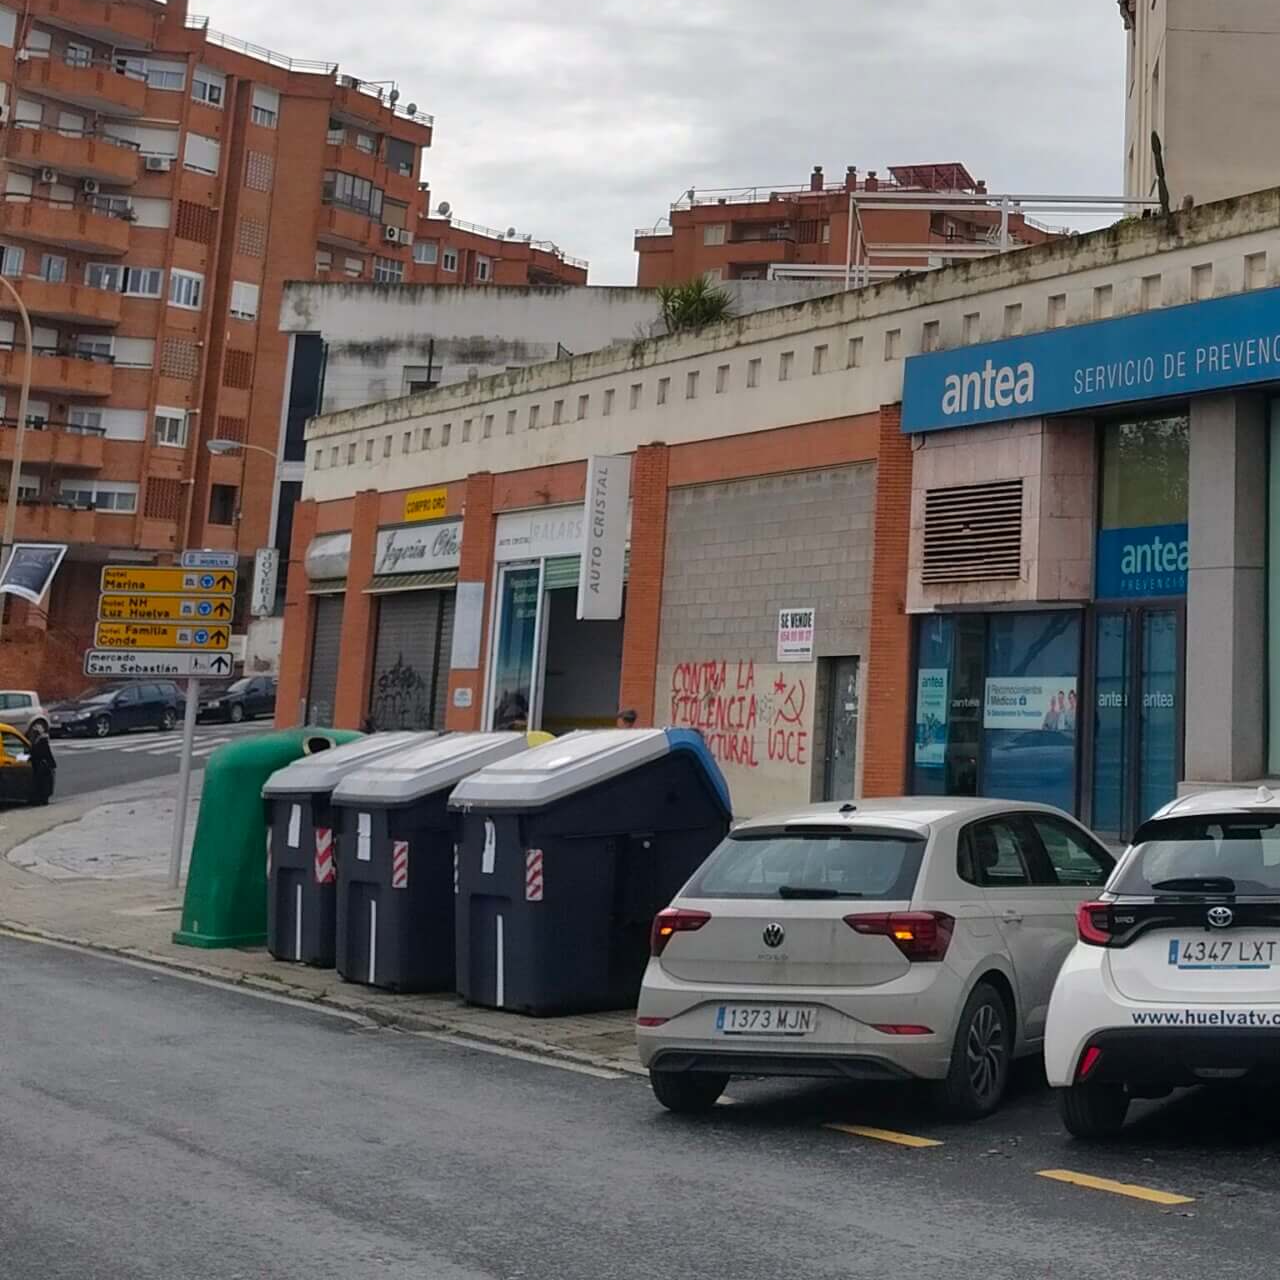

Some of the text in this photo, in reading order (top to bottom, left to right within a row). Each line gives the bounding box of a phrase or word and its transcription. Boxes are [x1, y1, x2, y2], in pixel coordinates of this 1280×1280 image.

[1073, 357, 1154, 395] SERVICIO
[1164, 351, 1186, 379] DE
[941, 359, 1035, 415] antea
[590, 467, 608, 594] AUTO CRISTAL
[1121, 535, 1189, 575] antea
[105, 580, 145, 590] Marina
[129, 598, 148, 608] NH
[103, 608, 170, 618] Luz Huelva
[781, 612, 812, 629] SE VENDE
[100, 635, 137, 645] Conde
[90, 653, 136, 662] mercado
[90, 664, 112, 673] San
[672, 658, 754, 695] CONTRA LA
[922, 675, 944, 688] antea
[1143, 691, 1174, 707] antea
[672, 693, 757, 730] VIOLENCIA
[706, 733, 758, 768] CTURAL
[1182, 941, 1277, 962] 4347 LXT
[730, 1010, 813, 1029] 1373 MJN
